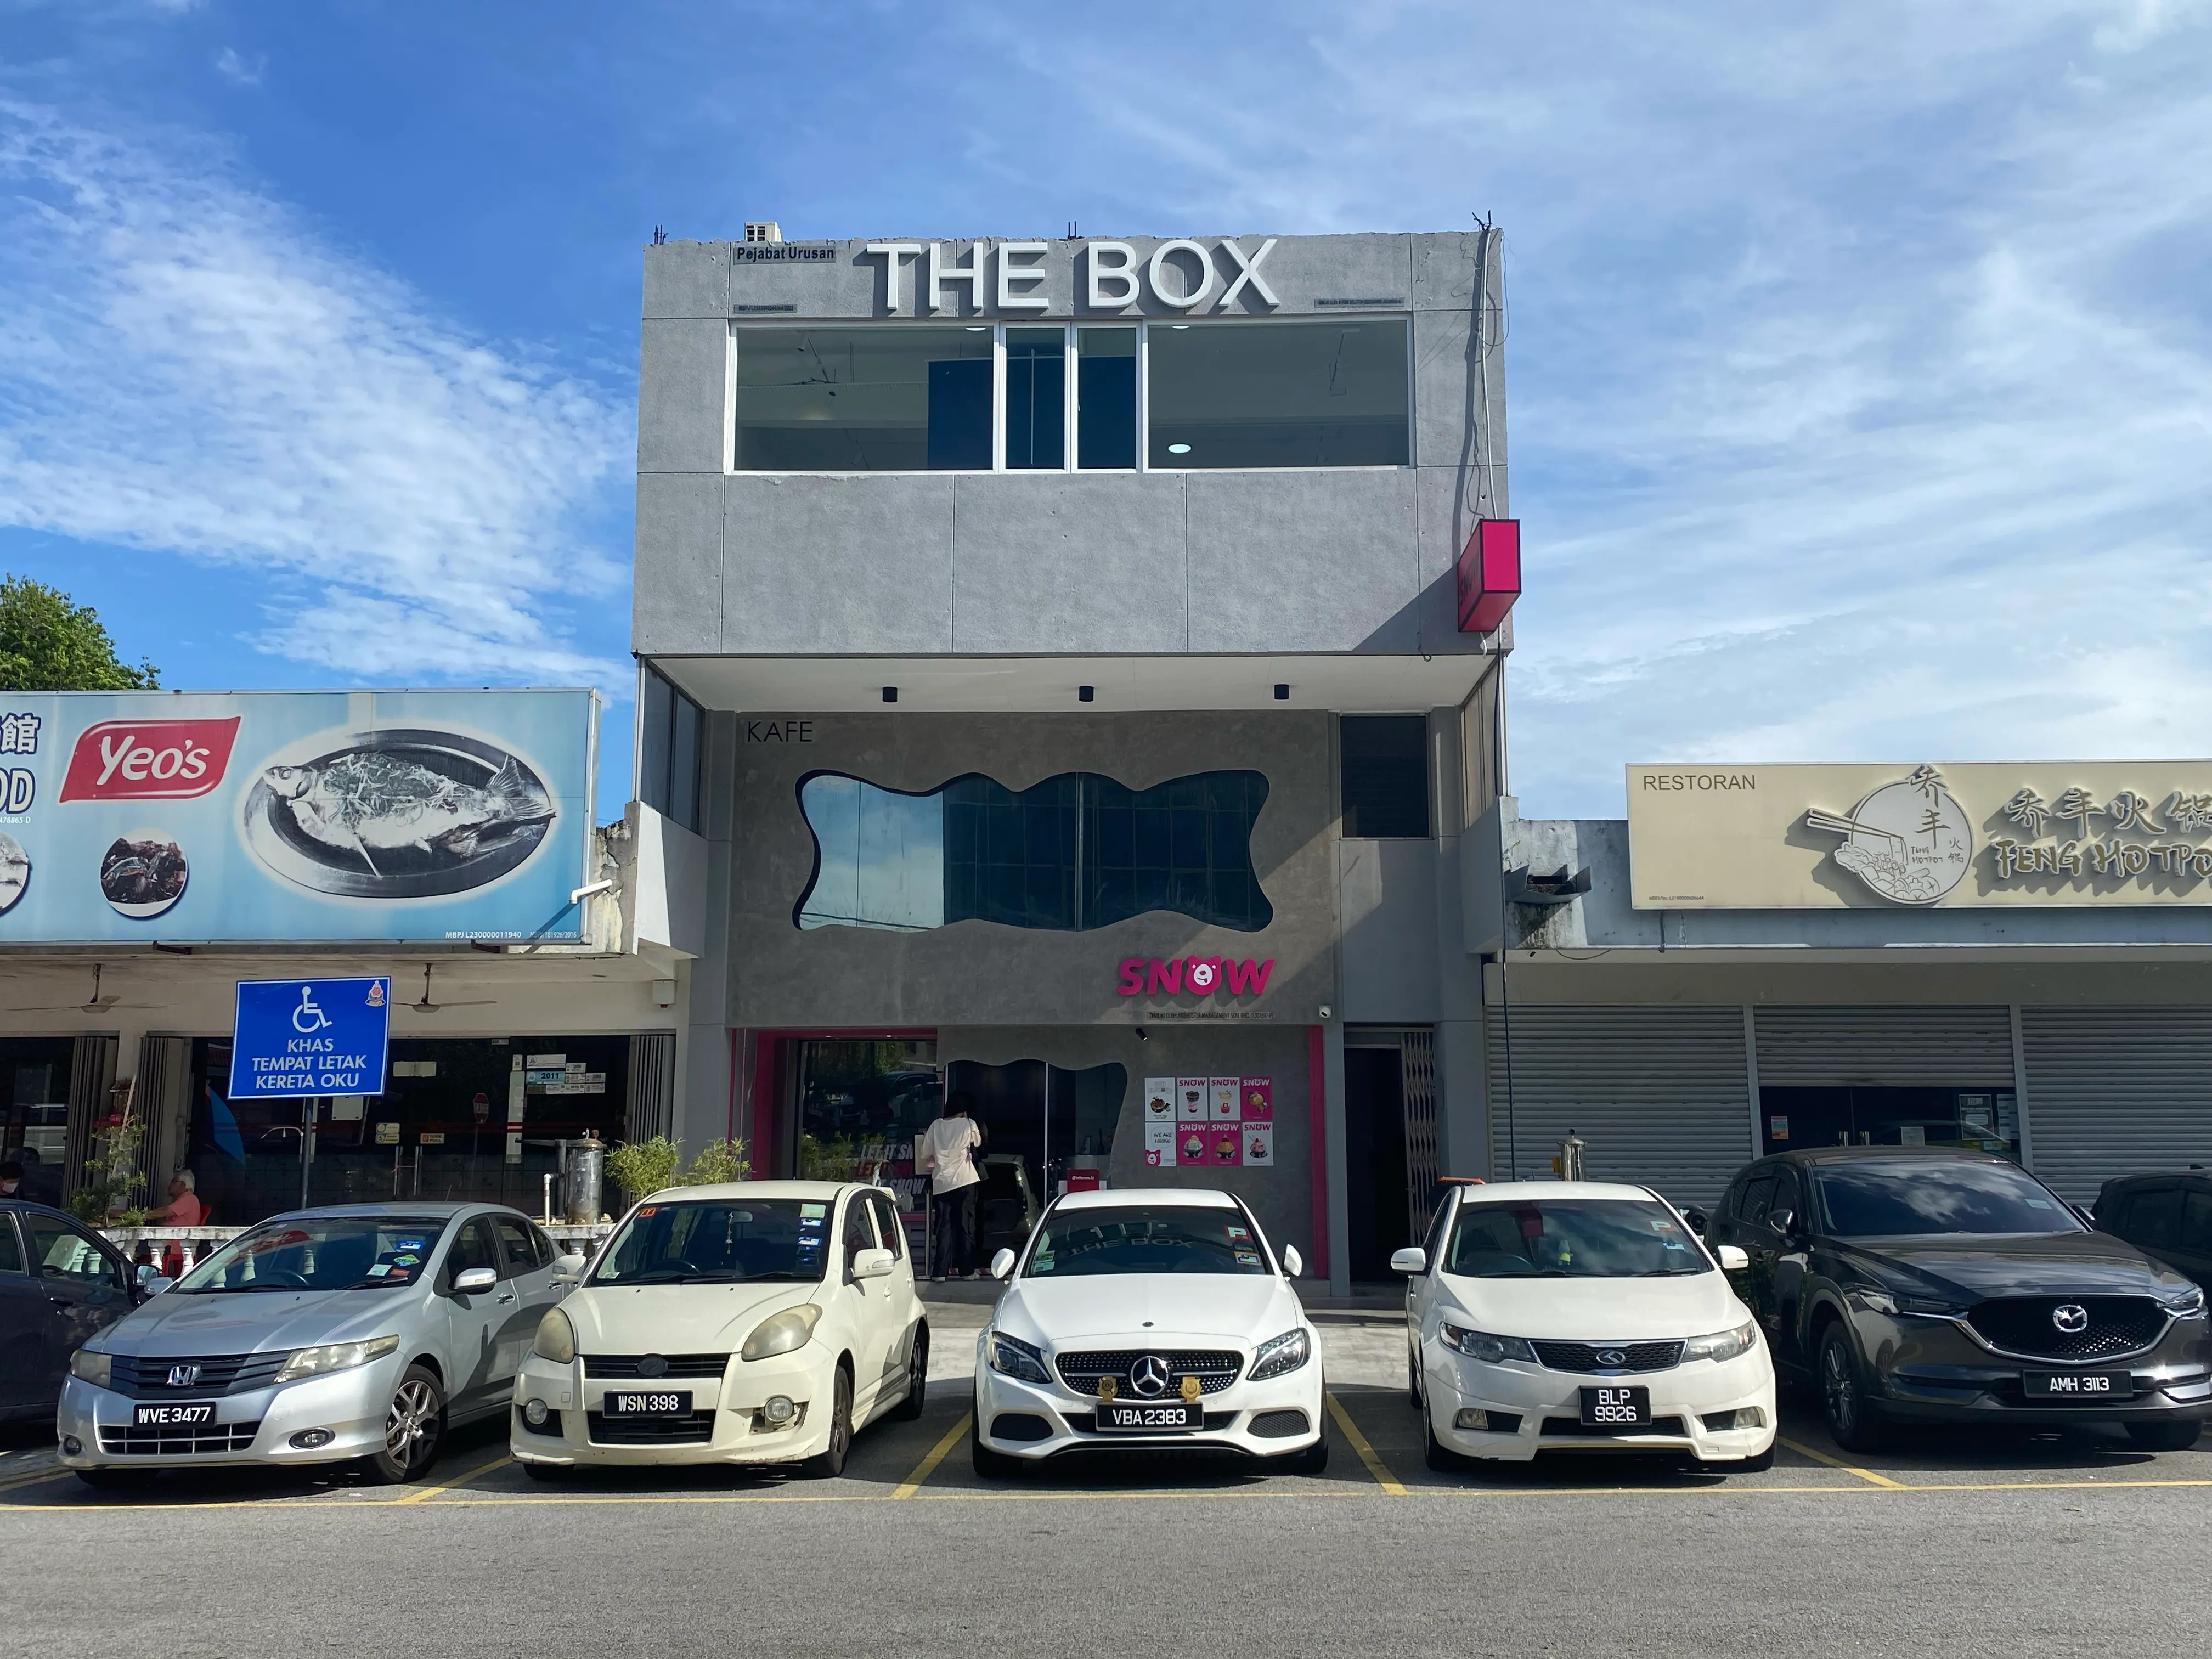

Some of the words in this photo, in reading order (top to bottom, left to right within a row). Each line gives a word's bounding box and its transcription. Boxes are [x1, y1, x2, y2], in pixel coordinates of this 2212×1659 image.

[737, 246, 785, 262] Pejabat
[789, 246, 834, 259] Urusan
[867, 242, 1048, 309] THE
[1088, 239, 1280, 308] BOX
[1, 714, 40, 753] 館
[748, 721, 812, 742] KAFE
[96, 735, 210, 785] Yeo's
[1644, 774, 1755, 791] RESTORAN
[1948, 837, 1964, 864] 火锅
[1995, 838, 2083, 878] FENG
[1912, 856, 1943, 864] HOTPOT
[1116, 955, 1276, 996] SNOW
[287, 1038, 334, 1053] KHAS
[252, 1056, 313, 1071] TEMPAT
[319, 1054, 366, 1070] LETAK
[256, 1074, 315, 1089] KERETA
[320, 1073, 359, 1087] OKU
[1243, 1078, 1270, 1086] SNOW
[1212, 1123, 1239, 1131] SNOW
[860, 1144, 883, 1160] LET
[884, 1144, 896, 1160] IT
[898, 1144, 913, 1160] SN
[1228, 1227, 1246, 1238] P
[1650, 1221, 1671, 1231] P
[2050, 1377, 2079, 1391] AMH
[2083, 1377, 2109, 1391] 3113
[618, 1395, 646, 1412] WSN
[649, 1395, 678, 1411] 398
[1598, 1389, 1630, 1404] BLP
[139, 1408, 170, 1423] WVE
[171, 1407, 211, 1422] 3477
[1113, 1409, 1143, 1425] VBA
[1145, 1408, 1186, 1425] 2383
[1595, 1406, 1637, 1422] 9926
